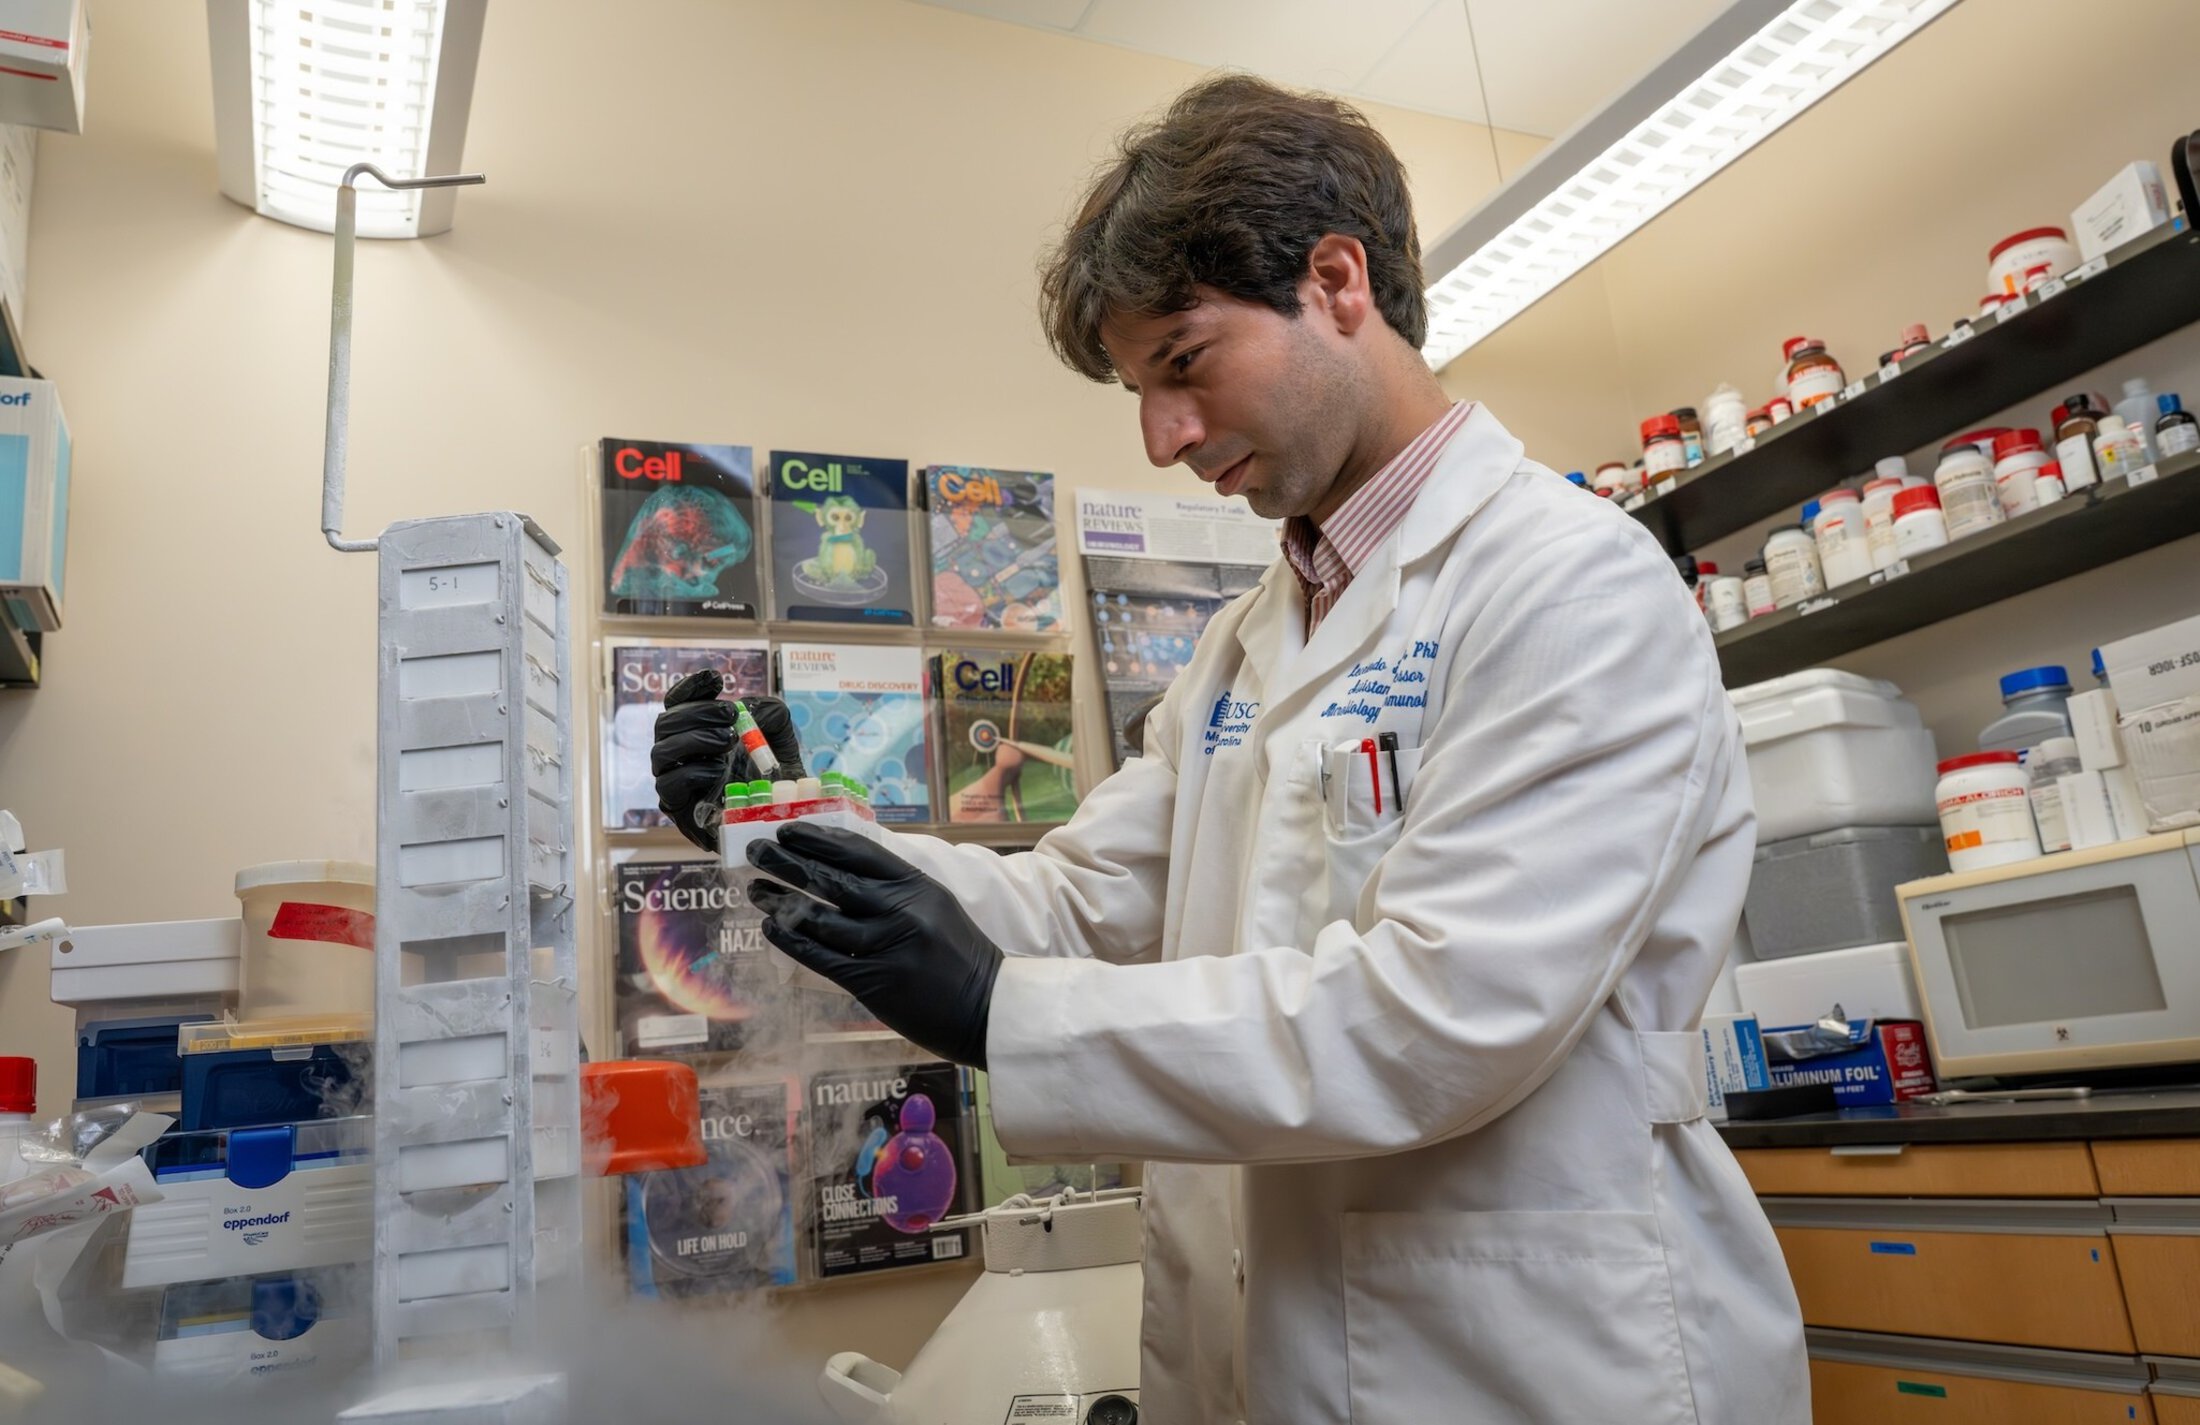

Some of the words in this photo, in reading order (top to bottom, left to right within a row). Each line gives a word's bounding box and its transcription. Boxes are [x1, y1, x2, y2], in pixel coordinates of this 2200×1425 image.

[615, 447, 682, 481] Cell
[781, 459, 842, 492] Cell
[938, 473, 1003, 506] Cell
[1083, 502, 1142, 520] nature
[1084, 518, 1144, 532] REVIEWS
[713, 602, 745, 611] CellPress
[789, 650, 836, 661] nature
[789, 662, 836, 672] REVIEWS
[955, 660, 1013, 692] Cell
[839, 681, 865, 689] DRUG
[867, 682, 918, 691] DISCOVERY
[2139, 721, 2152, 734] 10
[623, 879, 740, 913] Science
[719, 928, 764, 953] HAZE
[1708, 1056, 1723, 1107] Laboratory
[1770, 1068, 1843, 1089] ALUMINUM
[1844, 1066, 1879, 1082] FOIL
[817, 1077, 908, 1106] nature
[822, 1184, 856, 1204] CLOSE
[223, 1207, 238, 1215] Box
[240, 1205, 252, 1213] 2.0
[823, 1196, 899, 1222] CONNECTIONS
[223, 1211, 290, 1231] eppendorf
[677, 1237, 699, 1256] LIFE
[701, 1235, 717, 1252] ON
[718, 1231, 747, 1250] HOLD
[250, 1352, 265, 1361] Box
[266, 1350, 279, 1359] 2.0
